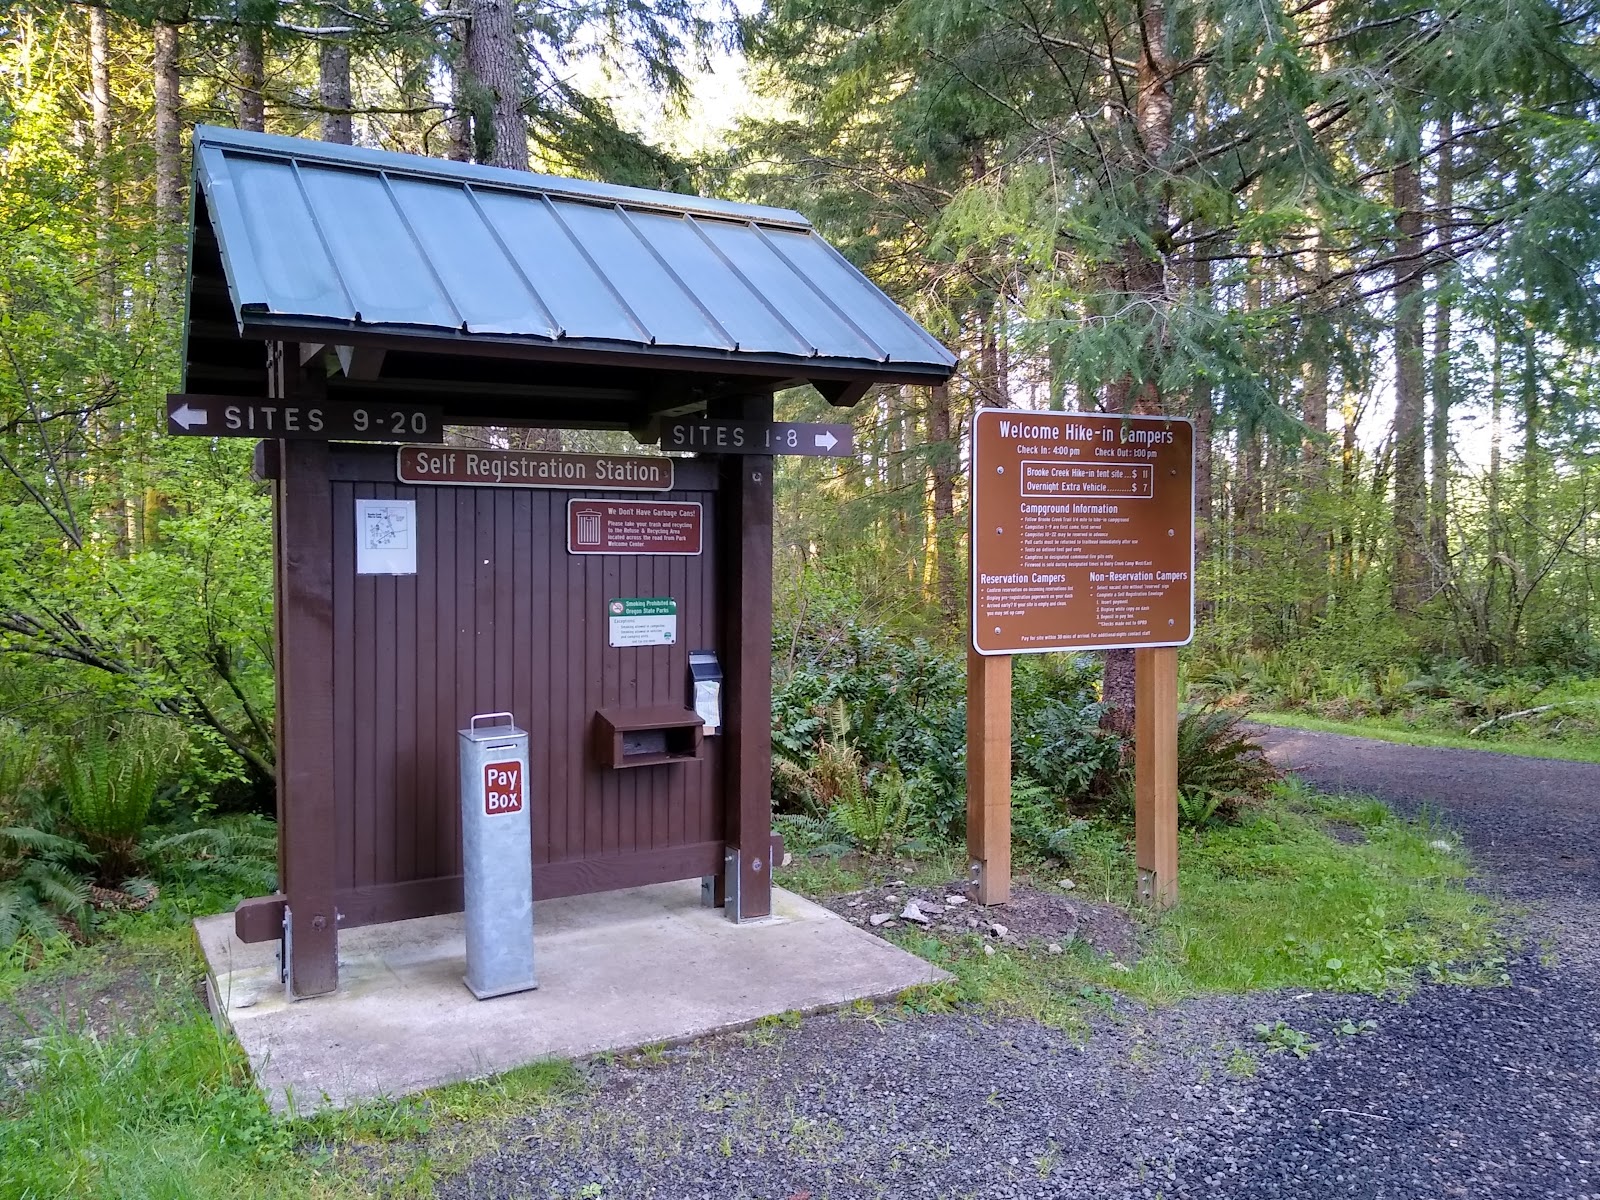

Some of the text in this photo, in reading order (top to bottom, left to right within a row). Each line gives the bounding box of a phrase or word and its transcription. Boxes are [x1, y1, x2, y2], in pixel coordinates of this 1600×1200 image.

[224, 406, 427, 434] SITES 9-20
[673, 425, 798, 448] SITES 1-8
[999, 420, 1173, 448] Welcome Hike-in Campers
[1017, 444, 1081, 457] Check In: 4:00 pm
[1094, 447, 1115, 457] Check
[1146, 450, 1158, 460] pm
[416, 452, 660, 482] Self Registration Station
[1026, 467, 1050, 477] Brooke
[1051, 467, 1070, 477] Creek
[1071, 468, 1095, 478] Hike-in
[1096, 469, 1110, 478] tent
[1131, 469, 1138, 479] $
[1142, 470, 1149, 479] 11
[1026, 481, 1060, 493] Overnight
[1061, 481, 1081, 492] Extra
[1131, 482, 1138, 493] $
[1143, 483, 1149, 492] 7
[608, 507, 617, 515] We
[618, 508, 635, 516] Don't
[636, 508, 651, 516] Have
[653, 509, 678, 518] Garbage
[1020, 502, 1118, 516] Campground Information
[980, 572, 1066, 586] Reservation Campers
[1089, 570, 1188, 583] Non-Reservation Campers
[625, 606, 669, 615] Oregon State Parks
[626, 600, 645, 608] Smoking
[487, 768, 518, 790] Pay
[488, 791, 518, 809] Box
